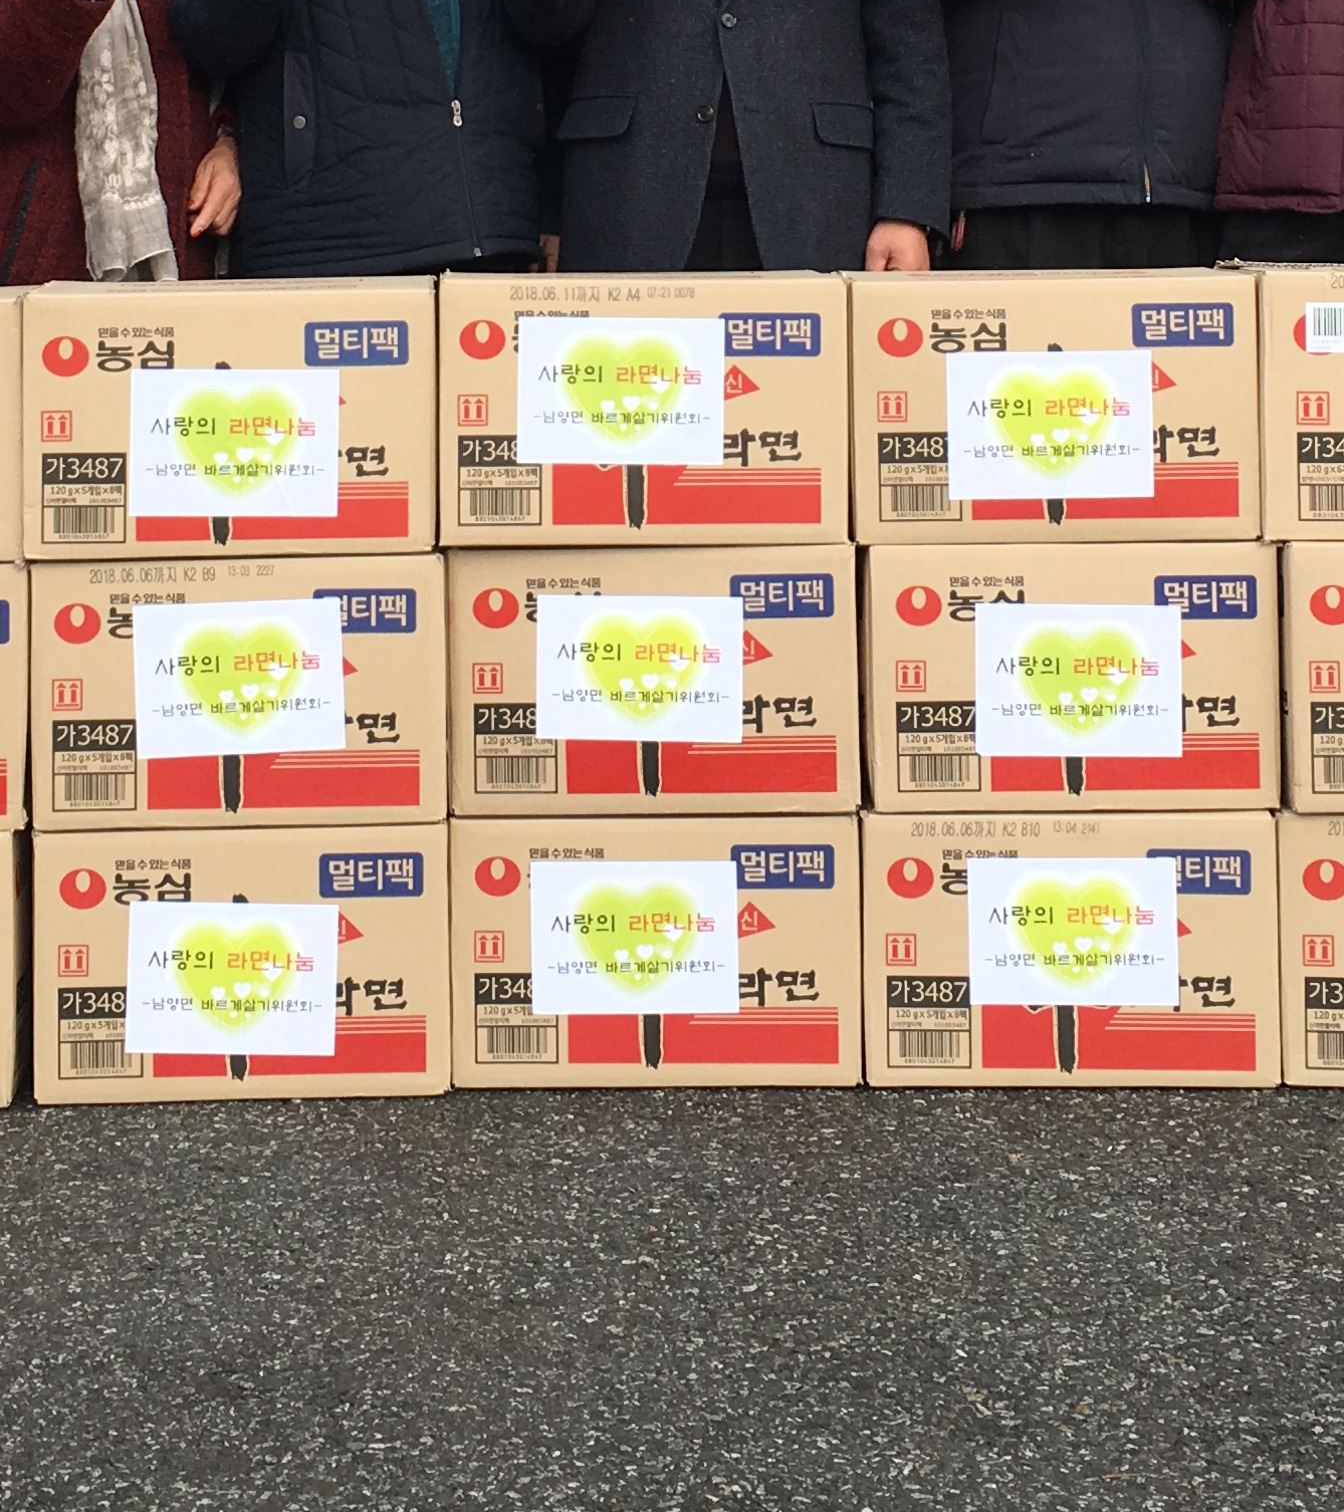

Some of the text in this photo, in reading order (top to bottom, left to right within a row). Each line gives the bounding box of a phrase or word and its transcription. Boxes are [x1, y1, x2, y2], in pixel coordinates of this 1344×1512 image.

[727, 319, 812, 350] 멀티팩
[930, 321, 1007, 353] 농심
[1140, 309, 1224, 341] 멀티팩
[96, 340, 175, 371] 농심
[314, 328, 399, 359] 멀티팩
[538, 365, 702, 385] 사랑의 라면나눔
[967, 399, 1131, 418] 사랑의 라면나눔
[151, 417, 317, 437] 사랑의 라면나눔
[46, 457, 123, 481] 가3487
[740, 580, 824, 611] 멀티팩
[1163, 582, 1247, 612] 멀티팩
[341, 593, 407, 627] 티팩
[155, 651, 321, 676] 사랑의 라면나눔
[557, 642, 721, 663] 사랑의 라면나눔
[995, 656, 1160, 677] 사랑의 라면나눔
[901, 707, 975, 729] 가3487
[56, 725, 133, 747] 가3487
[329, 858, 414, 890] 멀티팩
[740, 850, 825, 881] 멀티팩
[1176, 855, 1242, 888] 티팩
[113, 873, 192, 903] 농심
[550, 913, 714, 934] 사랑의 라면나눔
[740, 911, 758, 931] 신
[988, 906, 1154, 925] 사랑의 라면나눔
[148, 950, 314, 972] 사랑의 라면나눔
[739, 967, 819, 1007] 라면
[891, 980, 966, 1002] 가3487
